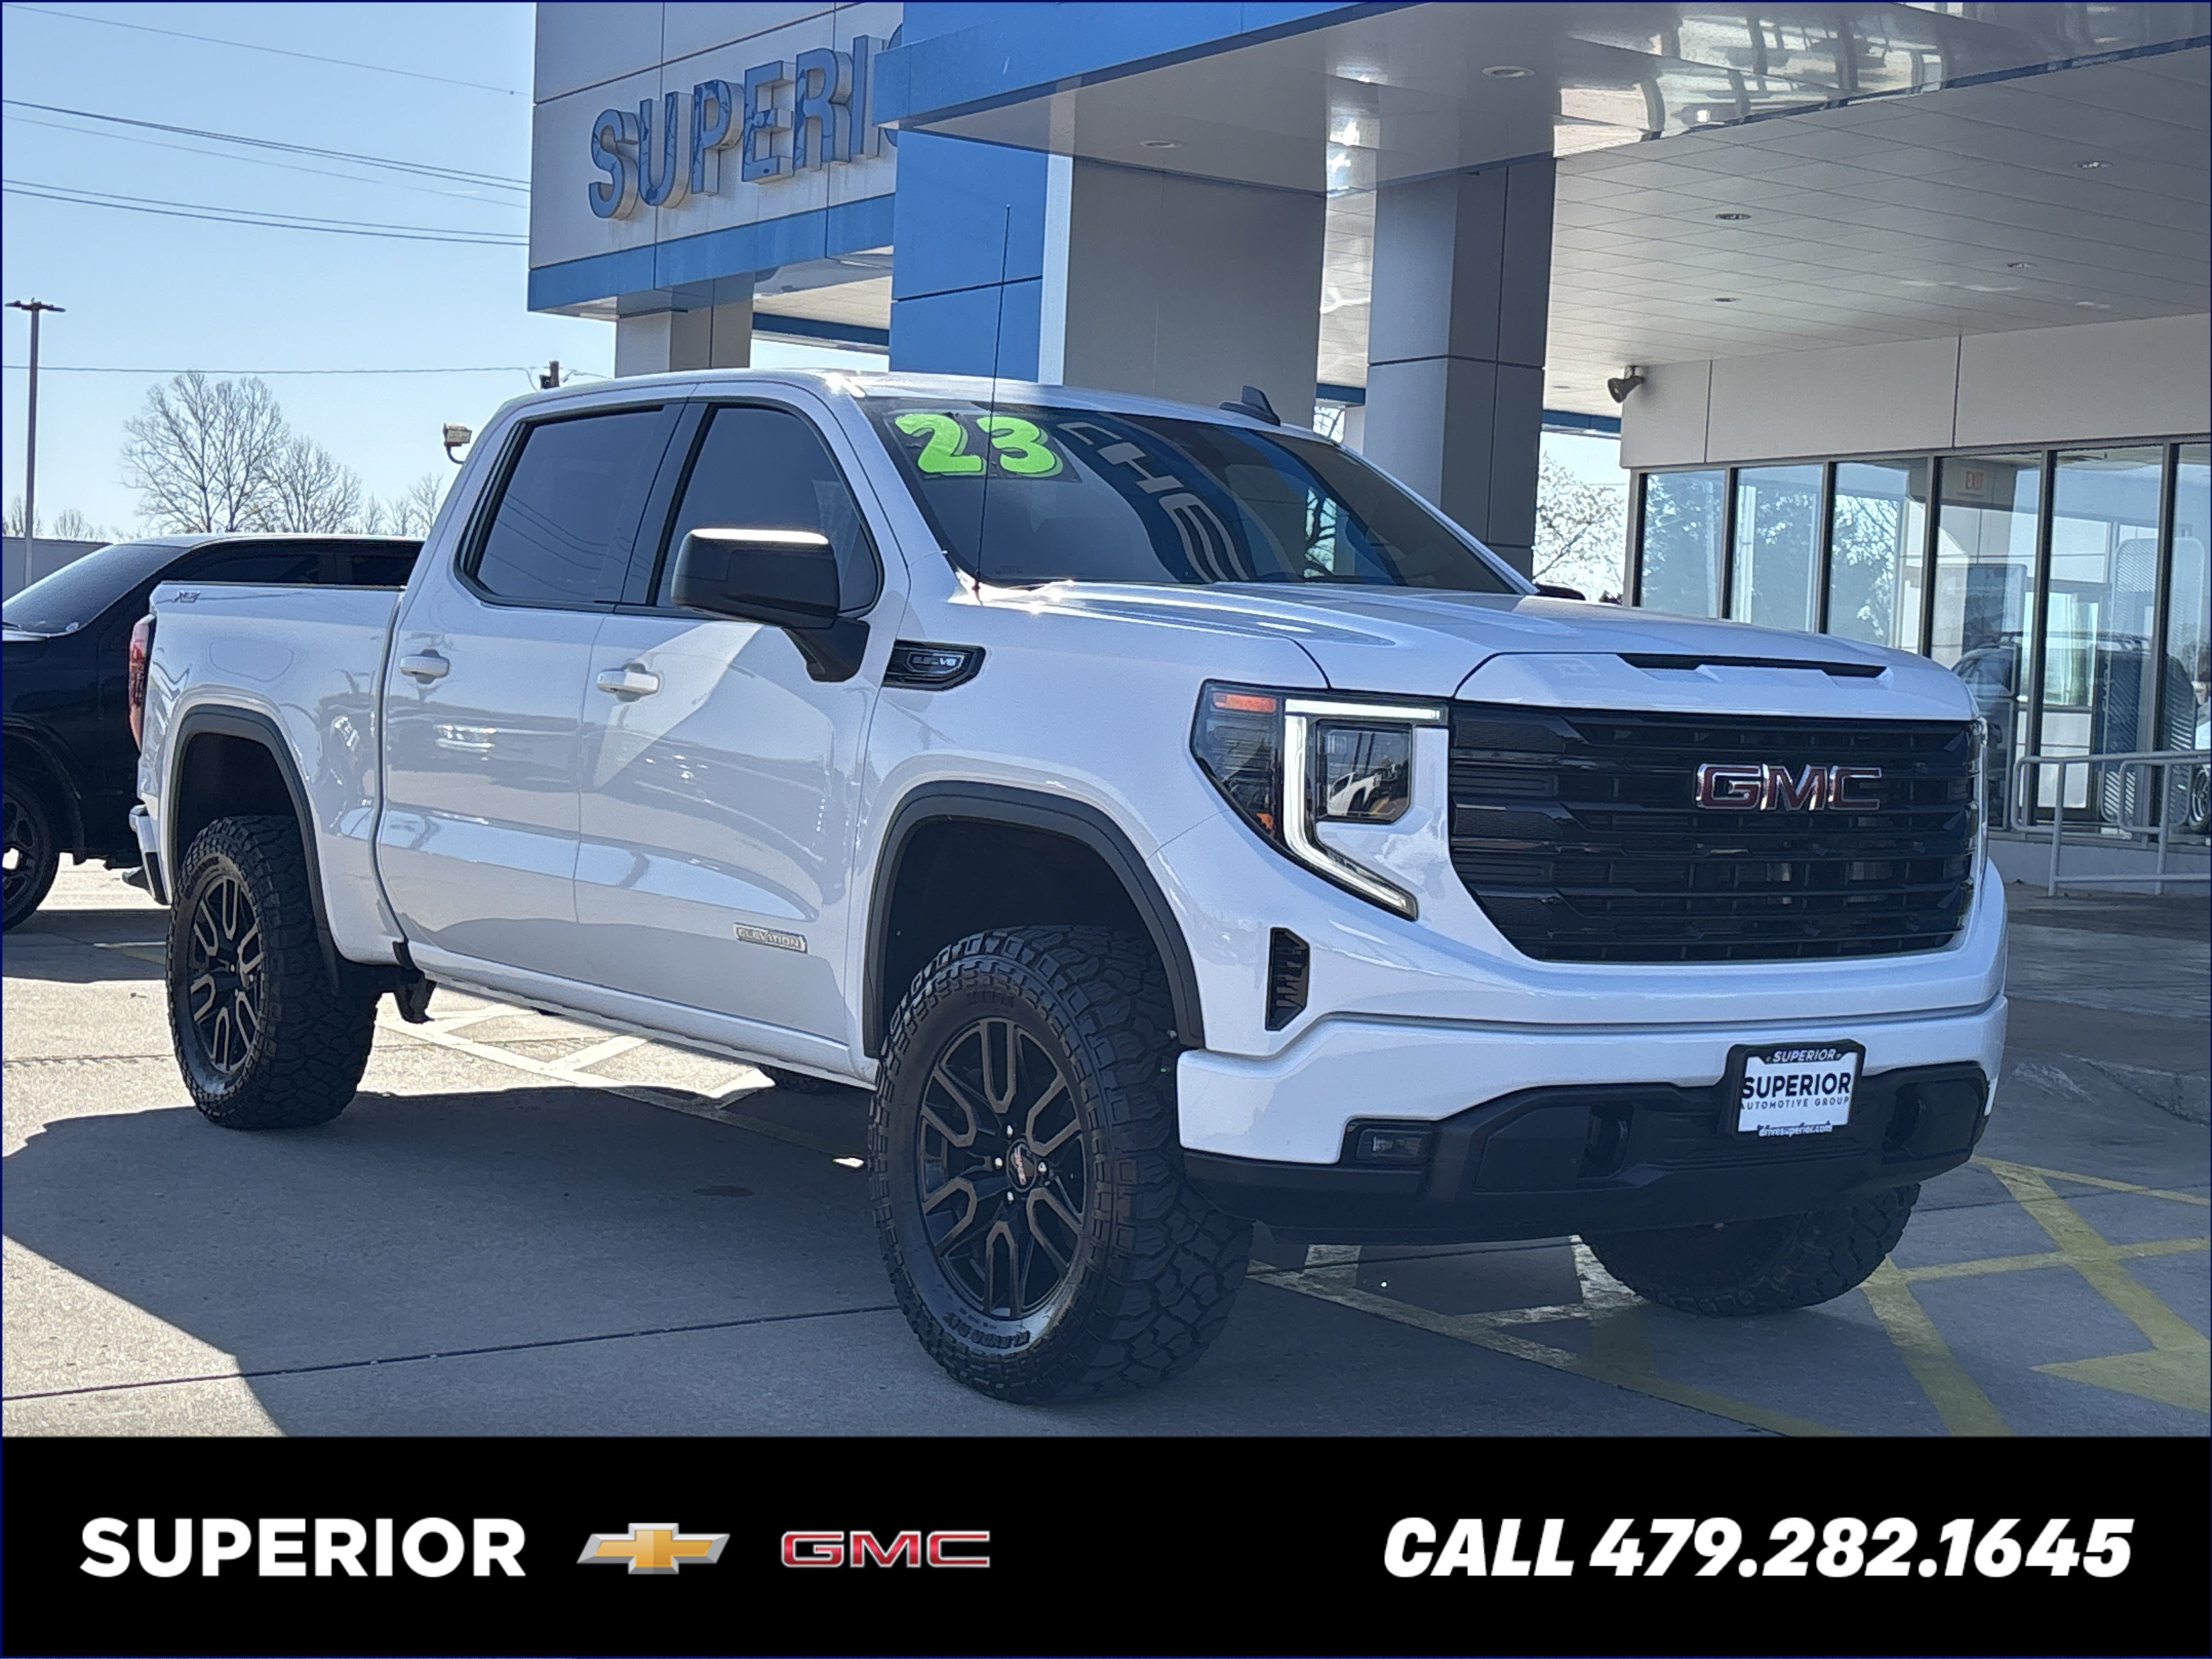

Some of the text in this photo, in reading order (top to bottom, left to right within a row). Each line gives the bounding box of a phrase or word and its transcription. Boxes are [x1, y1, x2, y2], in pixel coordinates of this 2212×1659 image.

[894, 414, 1064, 477] 23
[1695, 763, 1882, 811] GMC
[1773, 1048, 1837, 1063] SUPERIOR
[1741, 1072, 1852, 1099] SUPERIOR
[1814, 1096, 1849, 1107] GROUP
